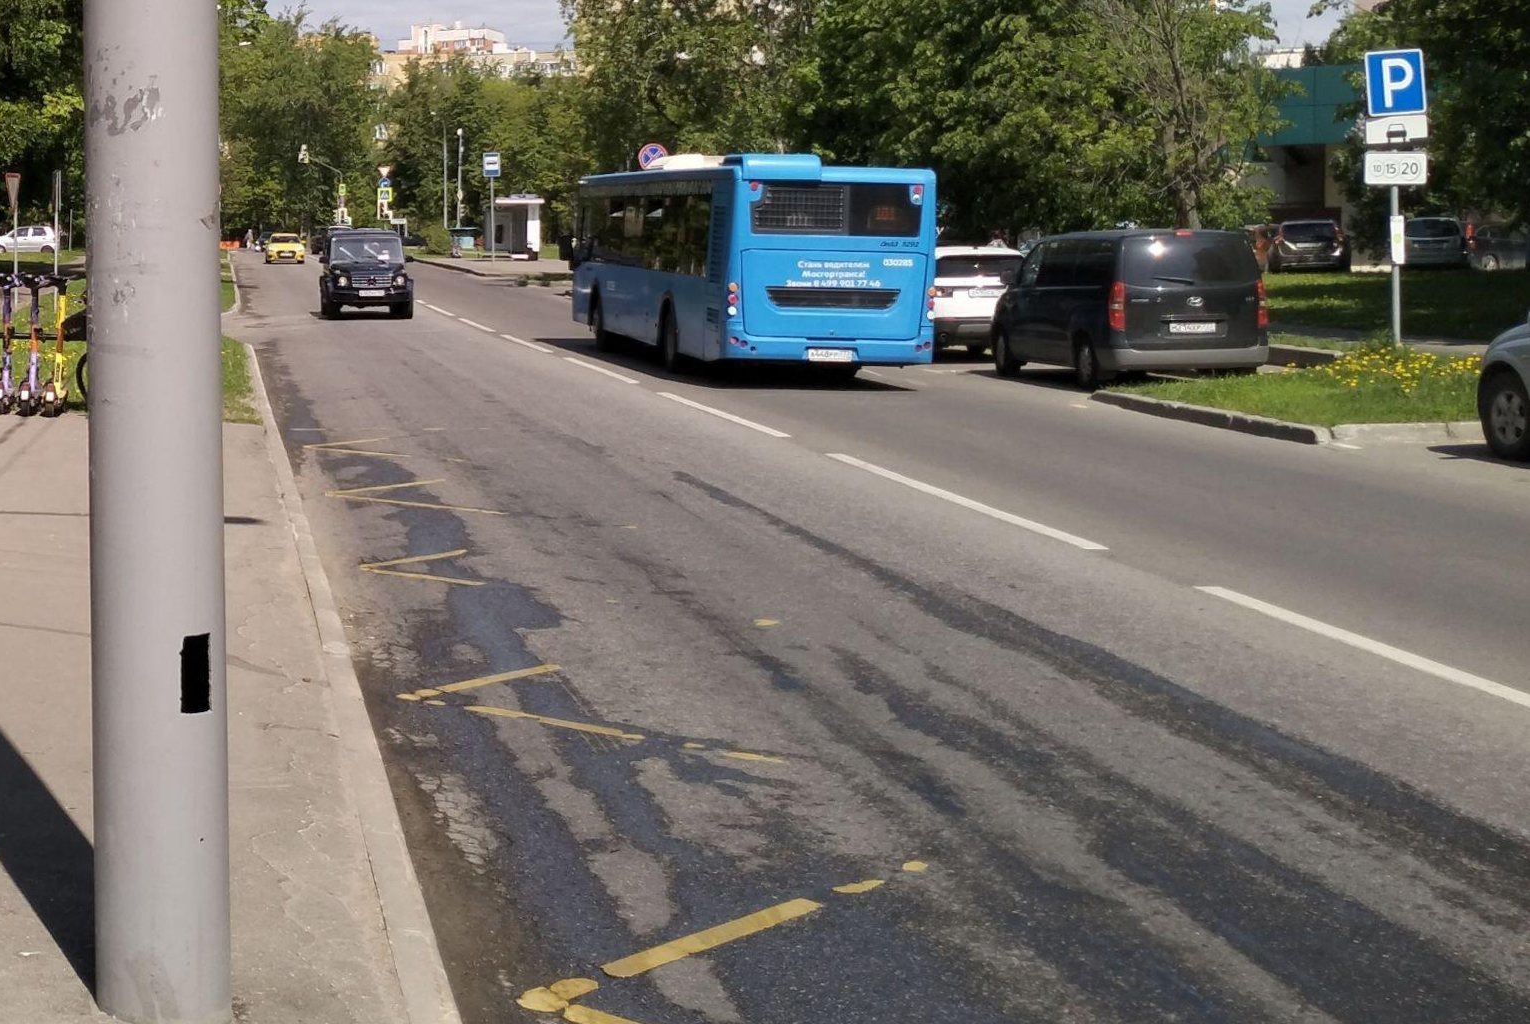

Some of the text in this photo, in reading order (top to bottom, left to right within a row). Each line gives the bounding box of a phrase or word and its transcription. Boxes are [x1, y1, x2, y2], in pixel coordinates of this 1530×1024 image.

[1381, 57, 1414, 109] P
[1372, 162, 1419, 175] 10 15 20
[797, 260, 822, 268] Стань
[839, 280, 855, 288] 901
[856, 280, 867, 288] 77
